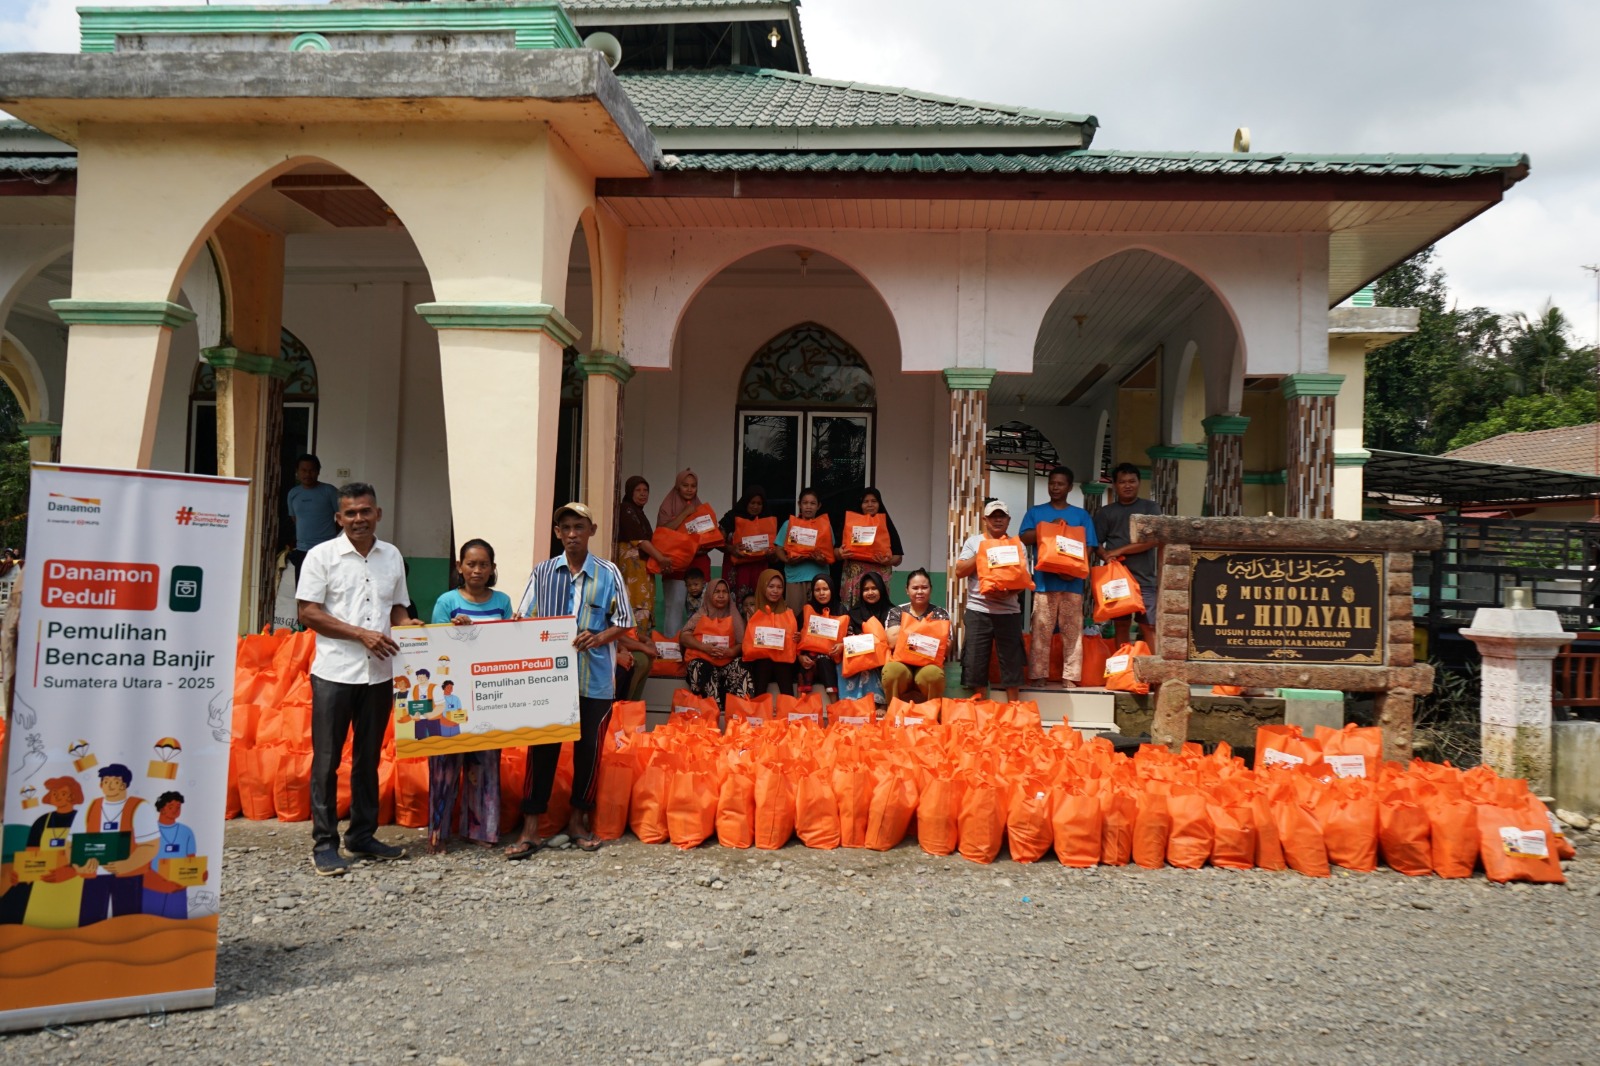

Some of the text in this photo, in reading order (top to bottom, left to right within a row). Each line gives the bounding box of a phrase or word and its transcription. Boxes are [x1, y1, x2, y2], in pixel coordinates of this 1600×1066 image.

[47, 501, 101, 513] Danamon
[49, 562, 153, 583] Danamon
[47, 586, 116, 605] Peduli
[1240, 585, 1330, 601] MUSHOLLA
[1198, 603, 1229, 626] AL
[1253, 604, 1372, 629] HIDAYAH
[46, 621, 168, 641] Pemulihan
[1215, 628, 1244, 637] DUSUN
[1250, 629, 1272, 637] DESA
[1274, 629, 1296, 638] PAYA
[1298, 630, 1352, 639] BENGKUANG
[1226, 638, 1246, 646] KEC.
[1247, 638, 1282, 647] GEBANG
[1306, 639, 1347, 648] LANGKAT
[45, 648, 215, 671] Bencana Banjir
[473, 659, 551, 673] Danamon Peduli
[43, 675, 118, 689] Sumatera
[122, 676, 162, 689] Utara
[178, 677, 215, 690] 2025
[475, 674, 569, 689] Pemulihan Bencana
[475, 690, 503, 702] Banjir
[476, 703, 508, 711] Sumatera
[532, 698, 550, 706] 2025
